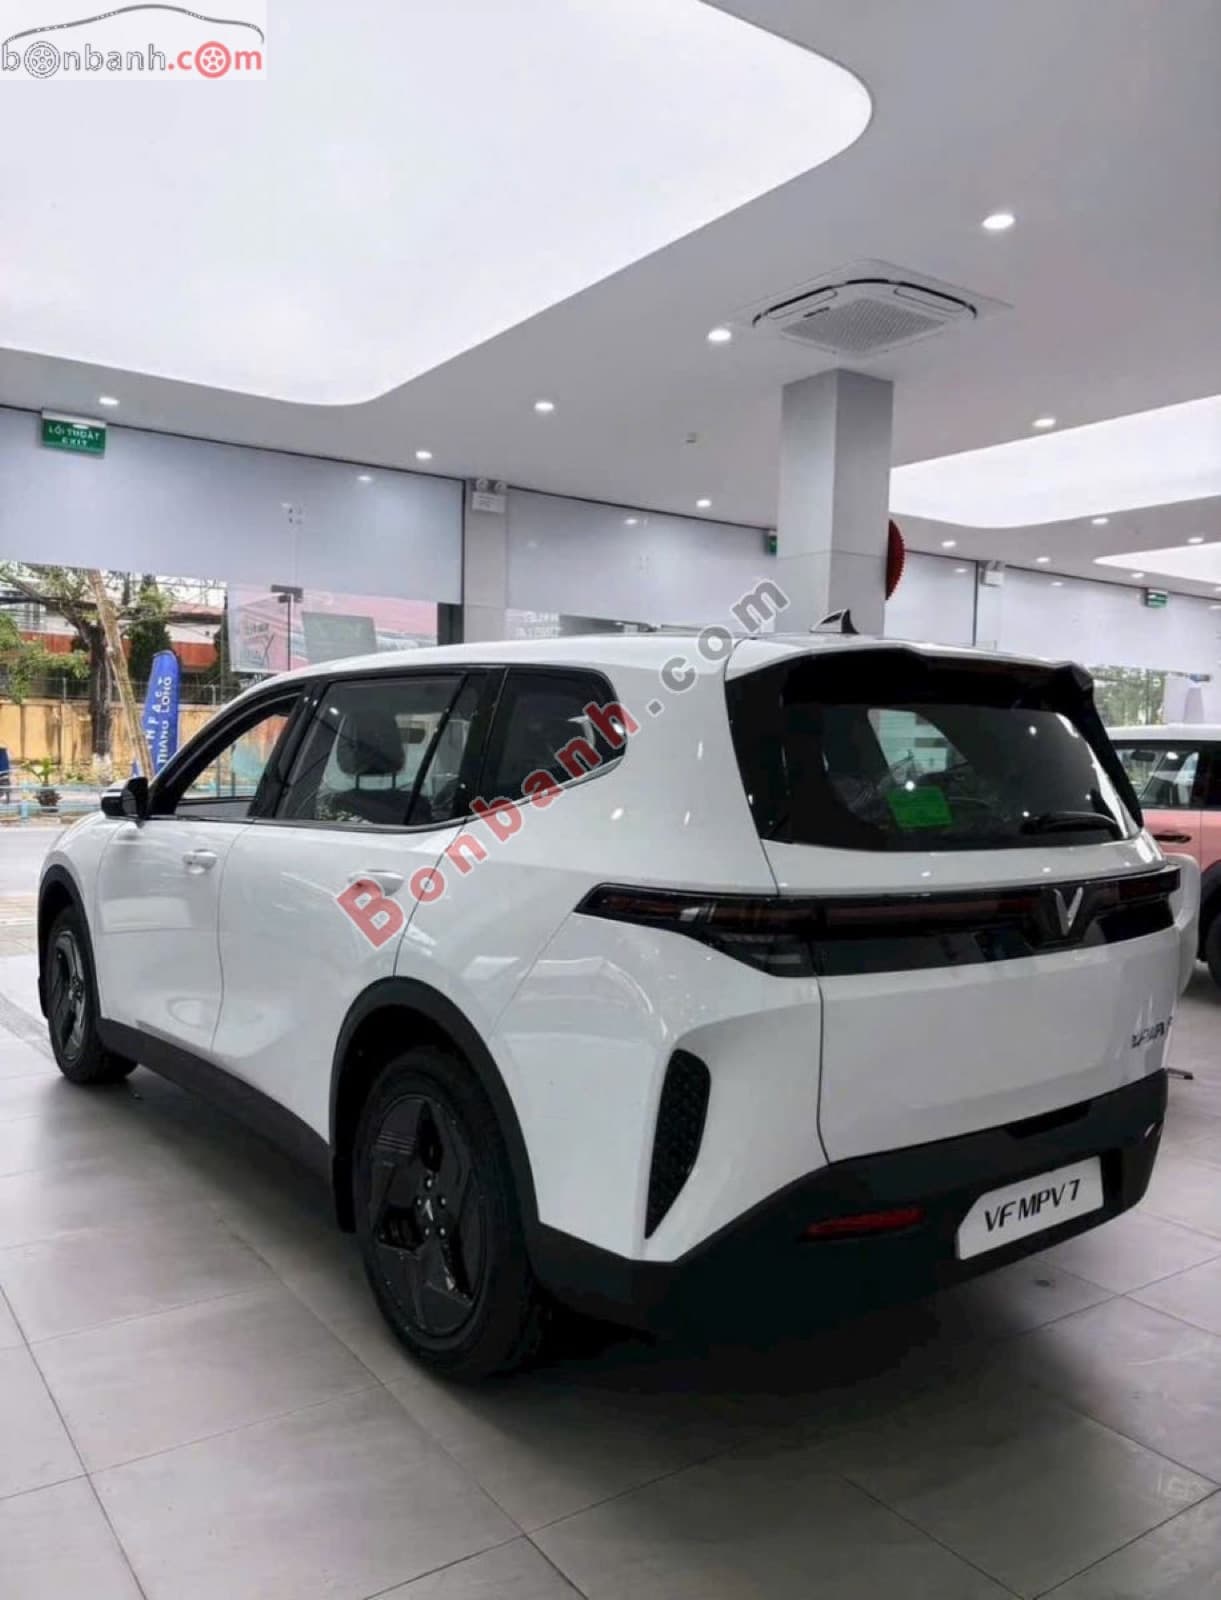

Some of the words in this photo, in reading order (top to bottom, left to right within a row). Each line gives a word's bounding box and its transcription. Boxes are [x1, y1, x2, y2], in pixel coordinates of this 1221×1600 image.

[984, 1200, 1016, 1232] VF
[1018, 1183, 1065, 1221] MPV
[1069, 1178, 1081, 1201] 7
